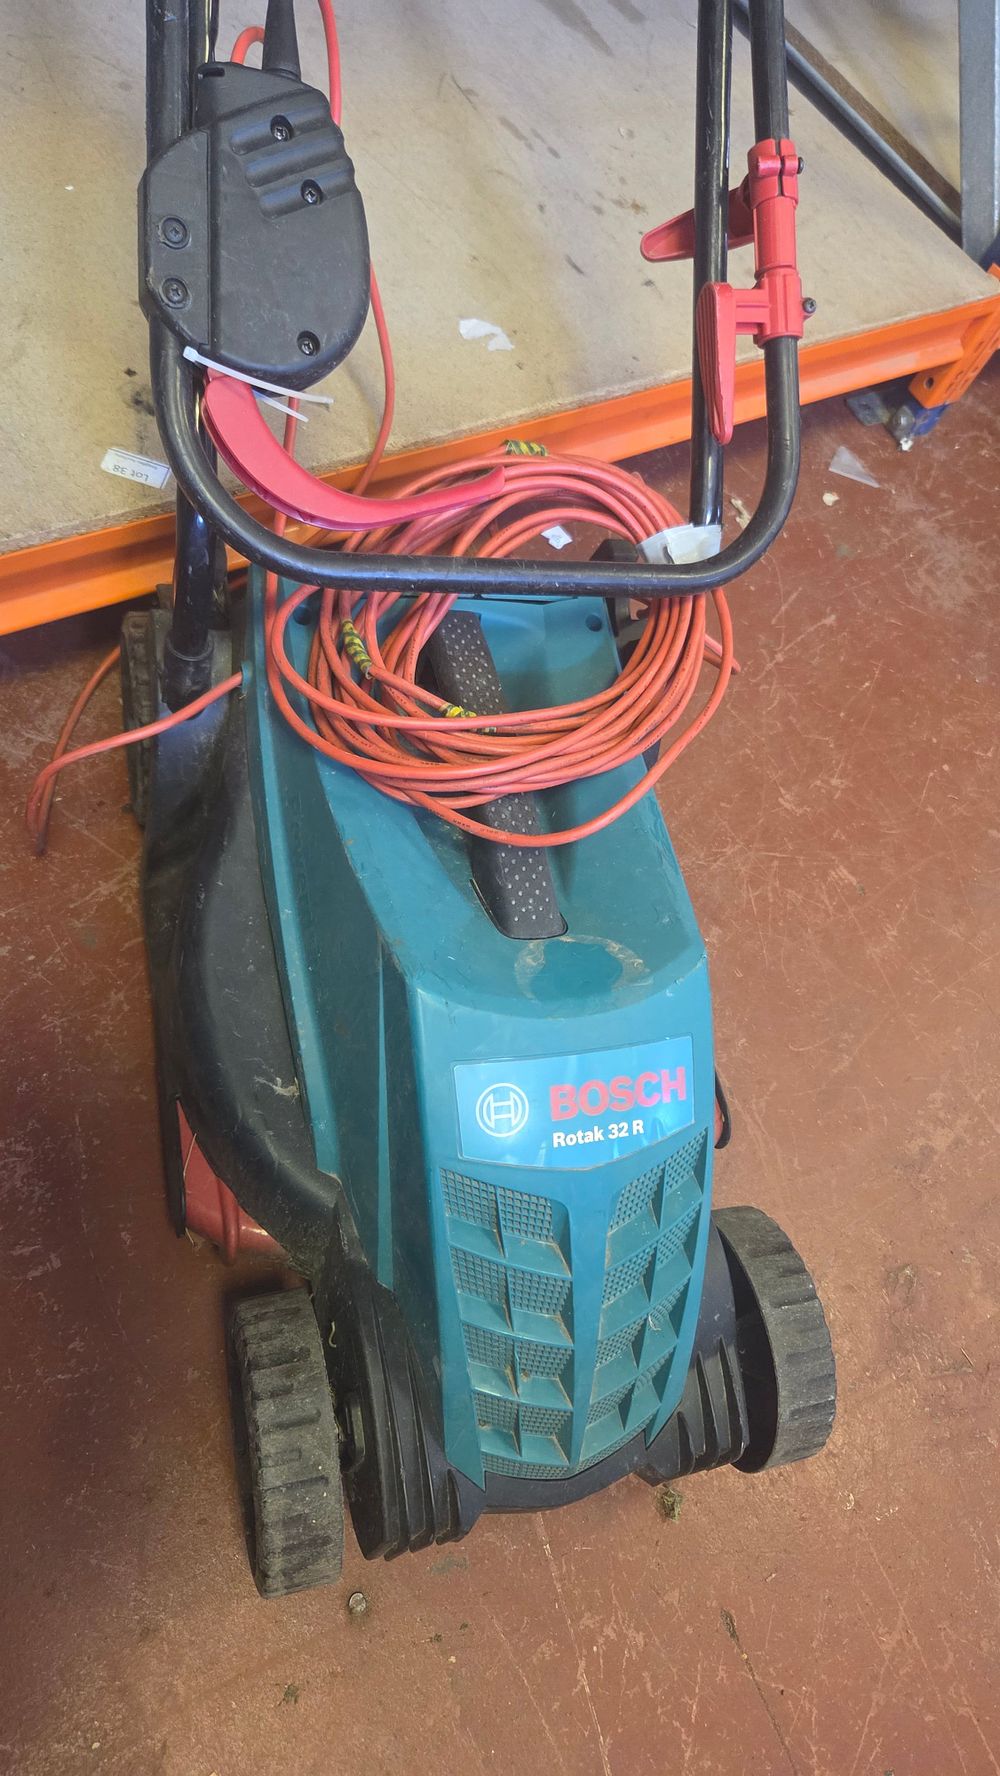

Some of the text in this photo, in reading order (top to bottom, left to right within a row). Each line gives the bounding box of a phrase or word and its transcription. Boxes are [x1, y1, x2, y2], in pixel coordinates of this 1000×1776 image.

[112, 465, 149, 482] Lot 38
[550, 1067, 687, 1121] BOSCH
[553, 1120, 644, 1148] Rotak 32 R
